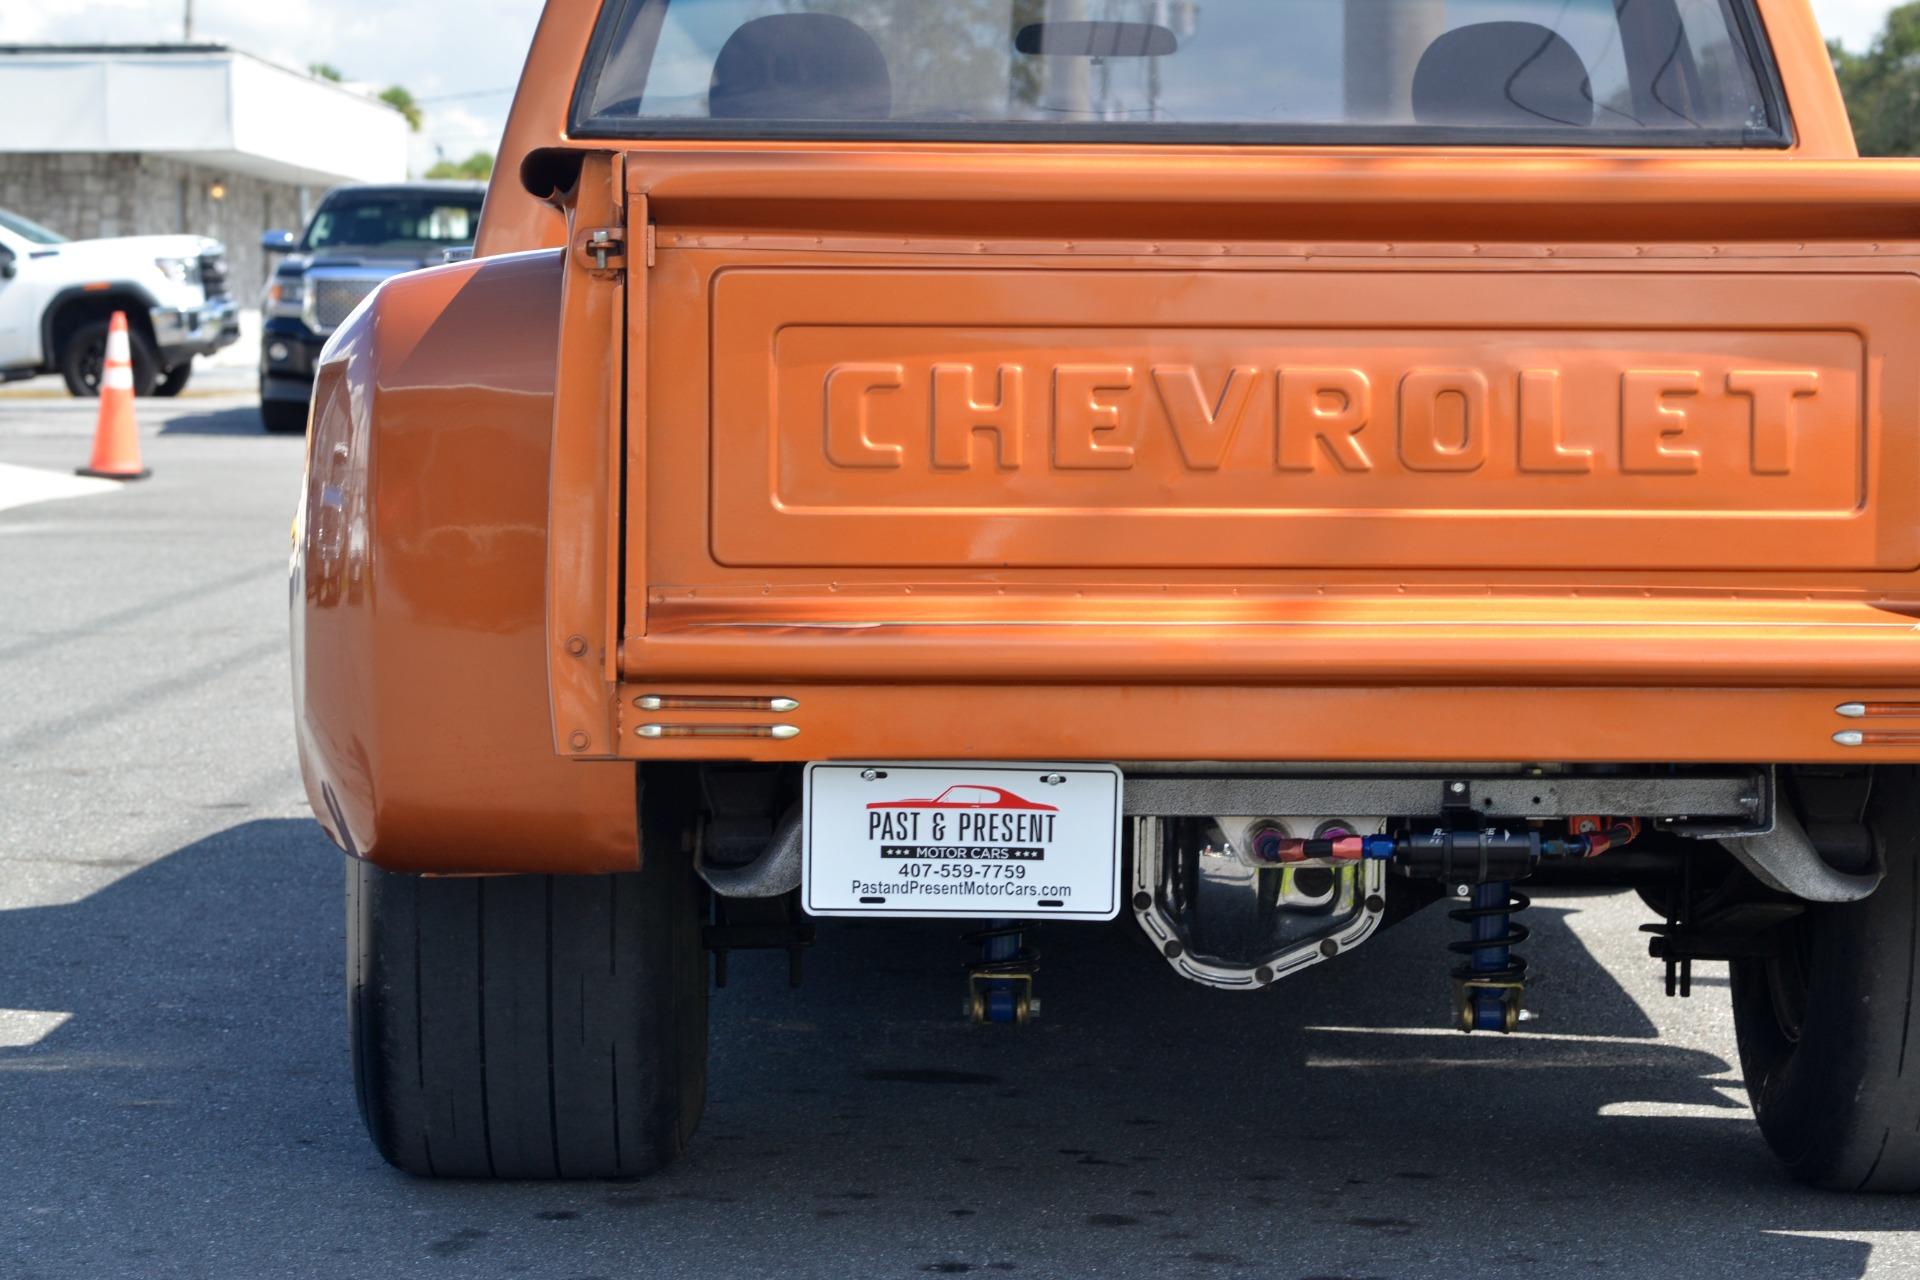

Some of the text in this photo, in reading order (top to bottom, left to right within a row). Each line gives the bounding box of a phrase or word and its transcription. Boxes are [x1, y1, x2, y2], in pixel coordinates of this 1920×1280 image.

[823, 361, 1820, 476] CHEVROLET
[868, 811, 1057, 843] PAST & PRESENT
[916, 847, 1010, 860] MOTOR CARS
[898, 863, 1026, 879] 407-559-7759
[852, 880, 1072, 897] PastandPresentMotorCars.com
